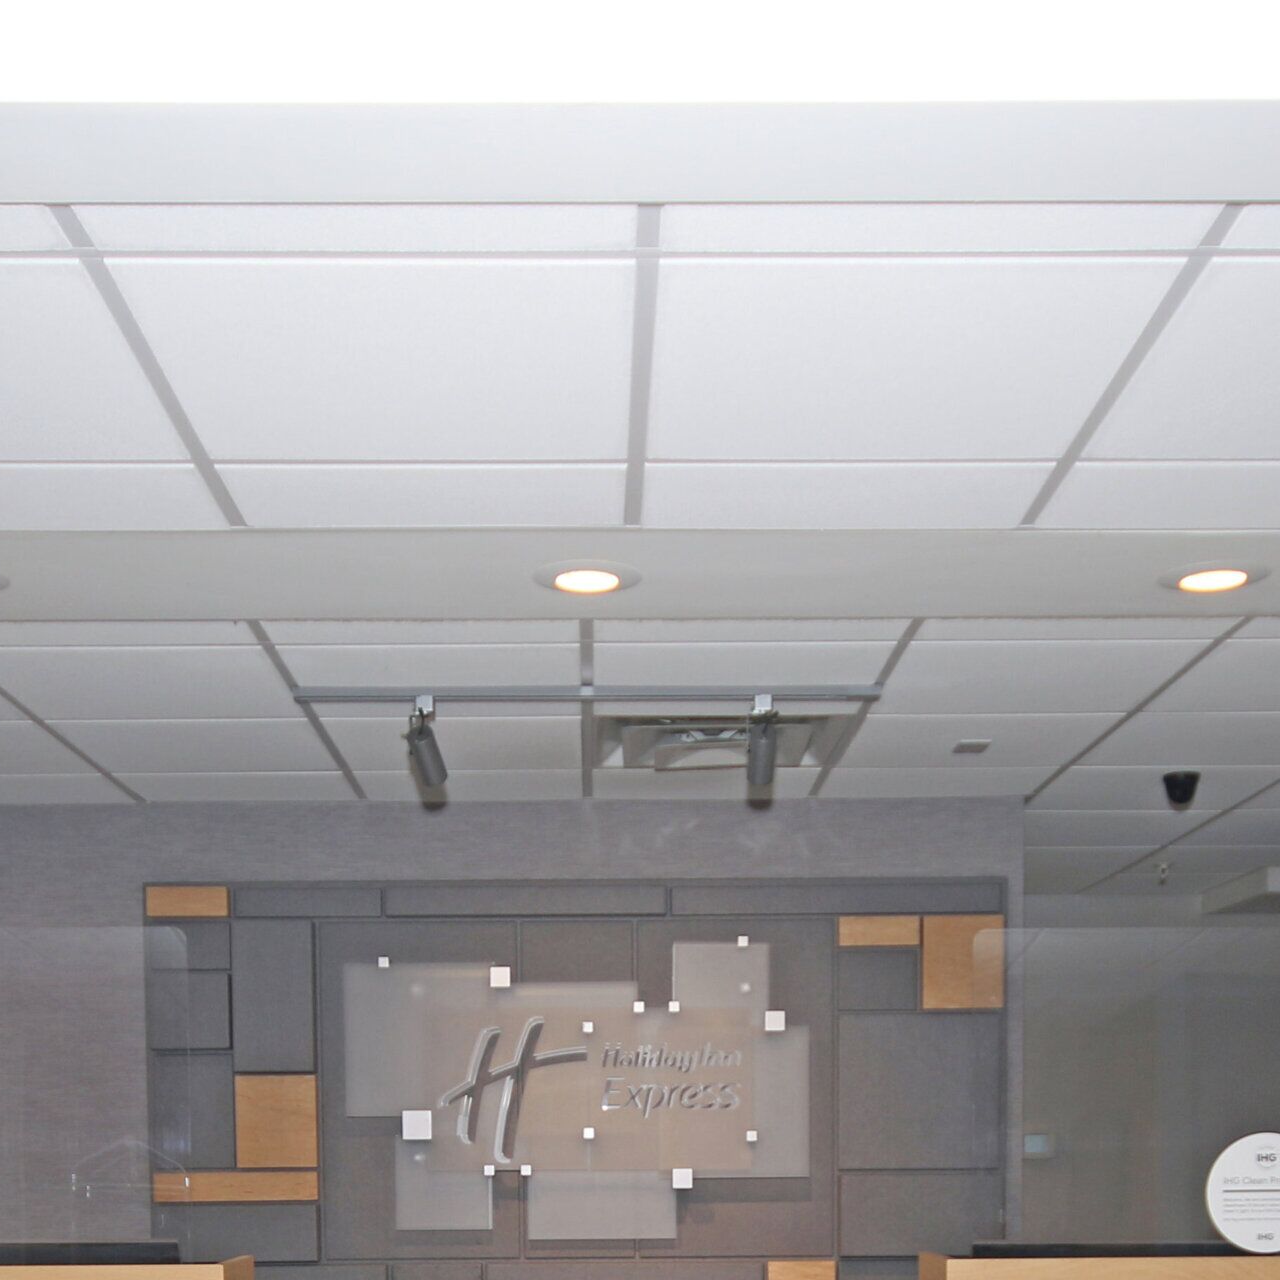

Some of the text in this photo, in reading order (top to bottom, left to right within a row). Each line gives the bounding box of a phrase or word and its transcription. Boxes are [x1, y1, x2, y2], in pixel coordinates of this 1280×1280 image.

[602, 1042, 694, 1072] Holiday
[602, 1076, 741, 1118] Express
[1257, 1153, 1277, 1162] IHG
[1223, 1176, 1240, 1185] IHG
[1242, 1176, 1269, 1185] Clean
[1257, 1232, 1275, 1240] IHG
